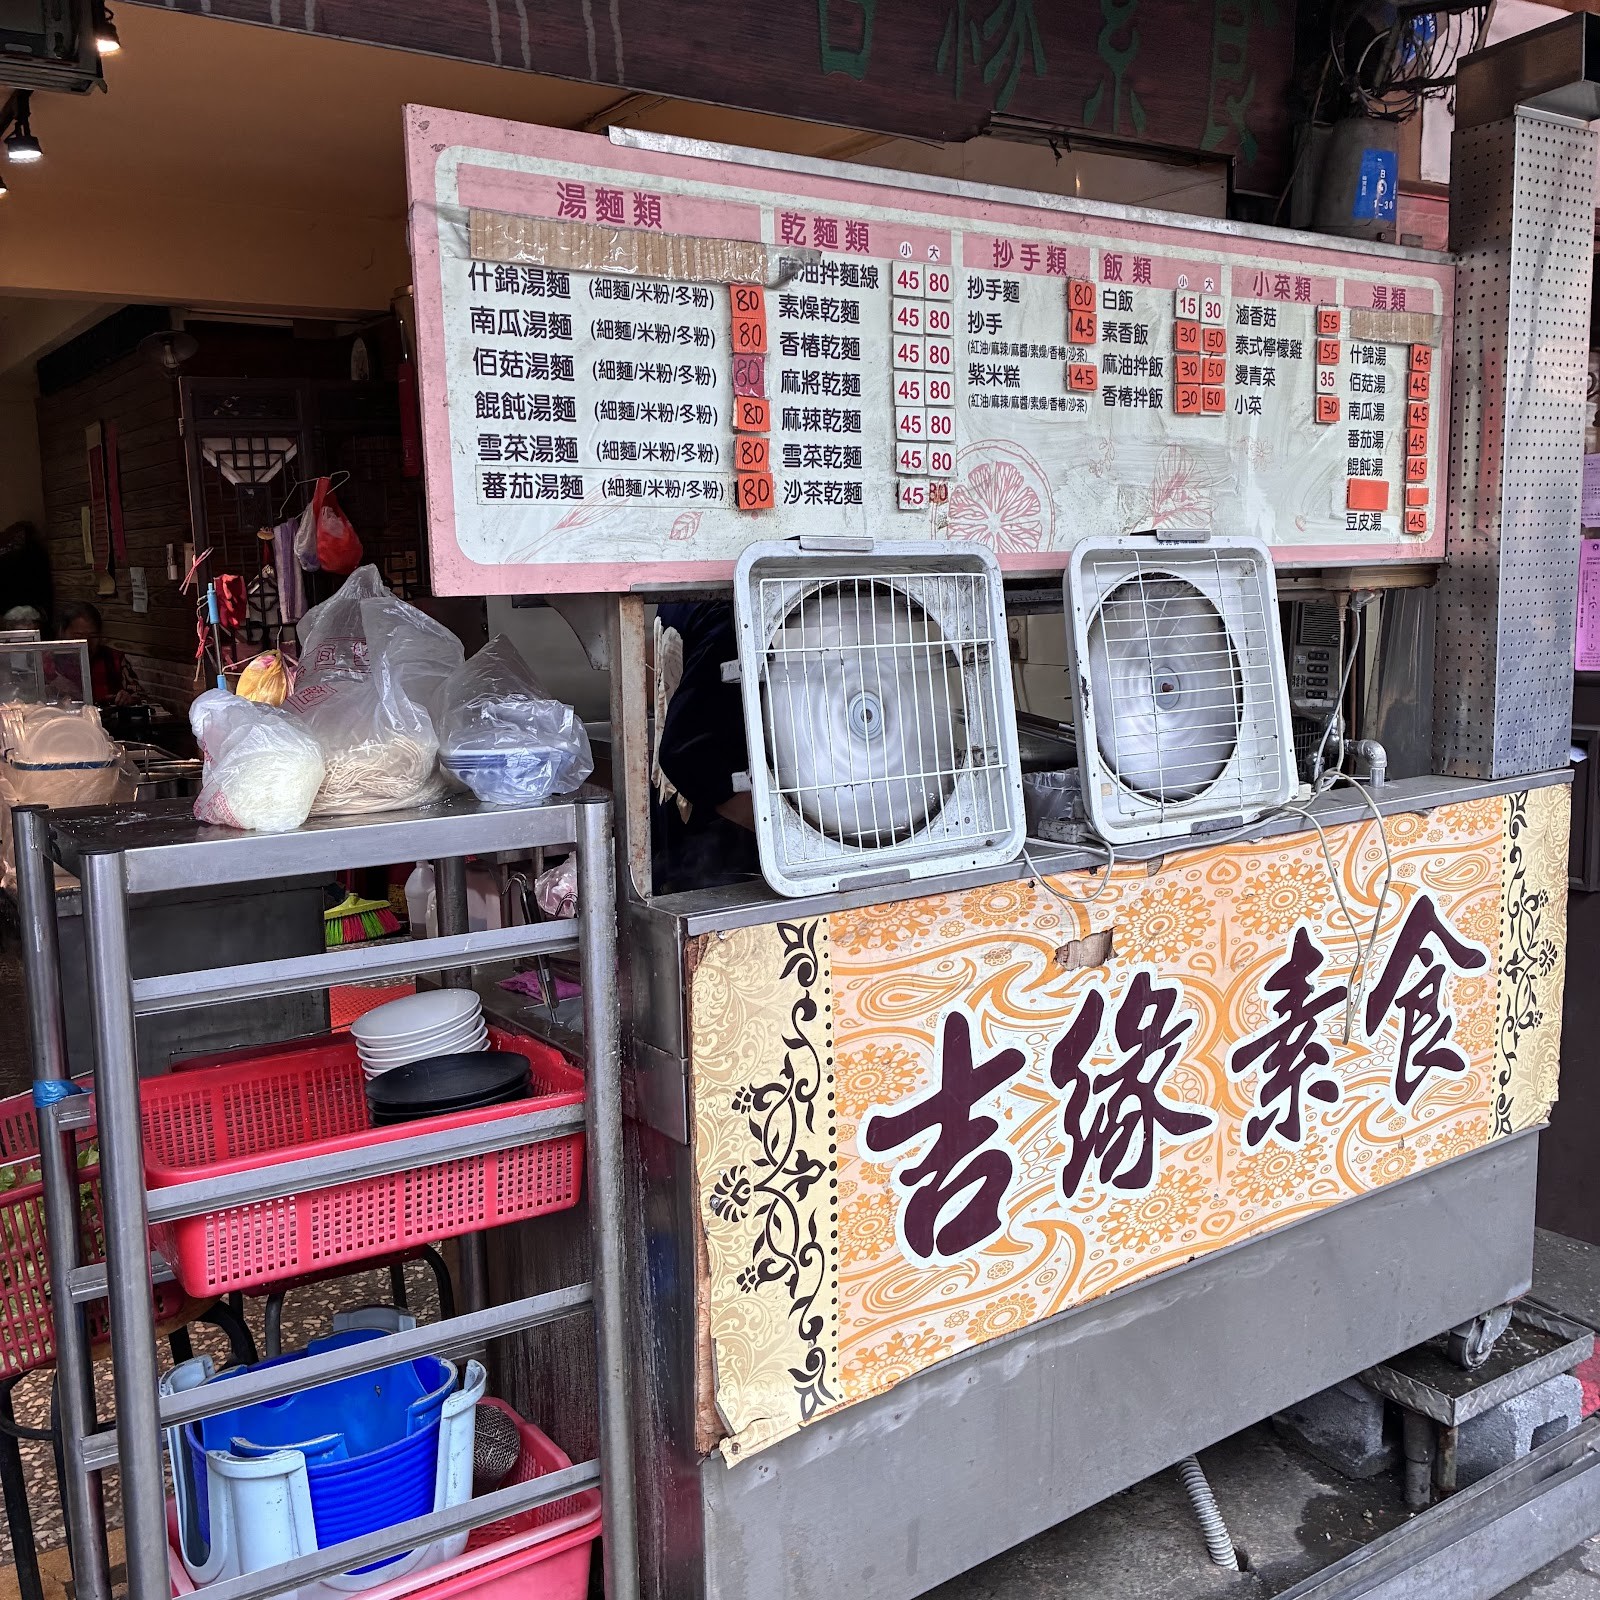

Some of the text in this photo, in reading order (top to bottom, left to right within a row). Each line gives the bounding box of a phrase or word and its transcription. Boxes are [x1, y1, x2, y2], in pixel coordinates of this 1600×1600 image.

[556, 182, 662, 230] 湯麵類
[780, 212, 870, 254] 乾麵類
[902, 243, 939, 259] 小 大
[993, 238, 1067, 276] 抄手類
[897, 270, 919, 290] 45
[929, 274, 950, 293] 80
[1103, 252, 1152, 285] 飯類
[1179, 275, 1213, 290] 小 大
[468, 262, 759, 311] 什錦湯麵 (細麵/米粉/冬粉) 80
[967, 275, 1093, 306] 抄手麵 80
[1253, 271, 1312, 303] 小菜類
[1372, 285, 1406, 312] 湯類
[779, 294, 950, 330] 素燥乾麵 45 80
[1102, 288, 1221, 319] 白飯 15 30
[1236, 304, 1338, 329] 滷香菇 55
[470, 306, 762, 350] 南瓜湯麵 (細麵/米粉/冬粉) 80
[967, 310, 1094, 338] 抄手 45
[1102, 321, 1223, 348] 素香飯 30 50
[780, 332, 950, 367] 香椿乾麵 45 80
[1323, 343, 1339, 360] 55
[1350, 344, 1429, 366] 什錦湯 45
[473, 347, 760, 387] 佰菇湯麵 (細麵/米粉/冬粉) 80
[968, 362, 1094, 388] 紫米糕 45
[1102, 353, 1223, 378] 麻油拌飯 30 50
[1235, 364, 1335, 387] 燙青菜 35
[781, 369, 951, 400] 麻將乾麵 45 80
[1102, 385, 1220, 409] 香椿拌飯 30 50
[1349, 372, 1427, 394] 佰菇湯 45
[475, 391, 764, 426] 餛飩湯麵 (細麵/米粉/冬粉) 80
[1234, 395, 1338, 416] 小菜 30
[1348, 401, 1428, 422] 南瓜湯 45
[782, 406, 951, 435] 麻辣乾麵 45 80
[478, 434, 765, 465] 雪菜湯麵 (細麵/米粉/冬粉) 80
[1347, 429, 1425, 450] 番茄湯 45
[782, 443, 952, 471] 雪菜乾麵 45 80
[1346, 457, 1425, 477] 餛飩湯 45
[481, 472, 770, 506] 蕃茄湯麵 (細麵/米粉/冬粉) 80
[783, 479, 948, 506] 沙茶乾麵 45 80
[1345, 511, 1424, 532] 豆皮湯 45
[866, 894, 1488, 1259] 吉緣素食
